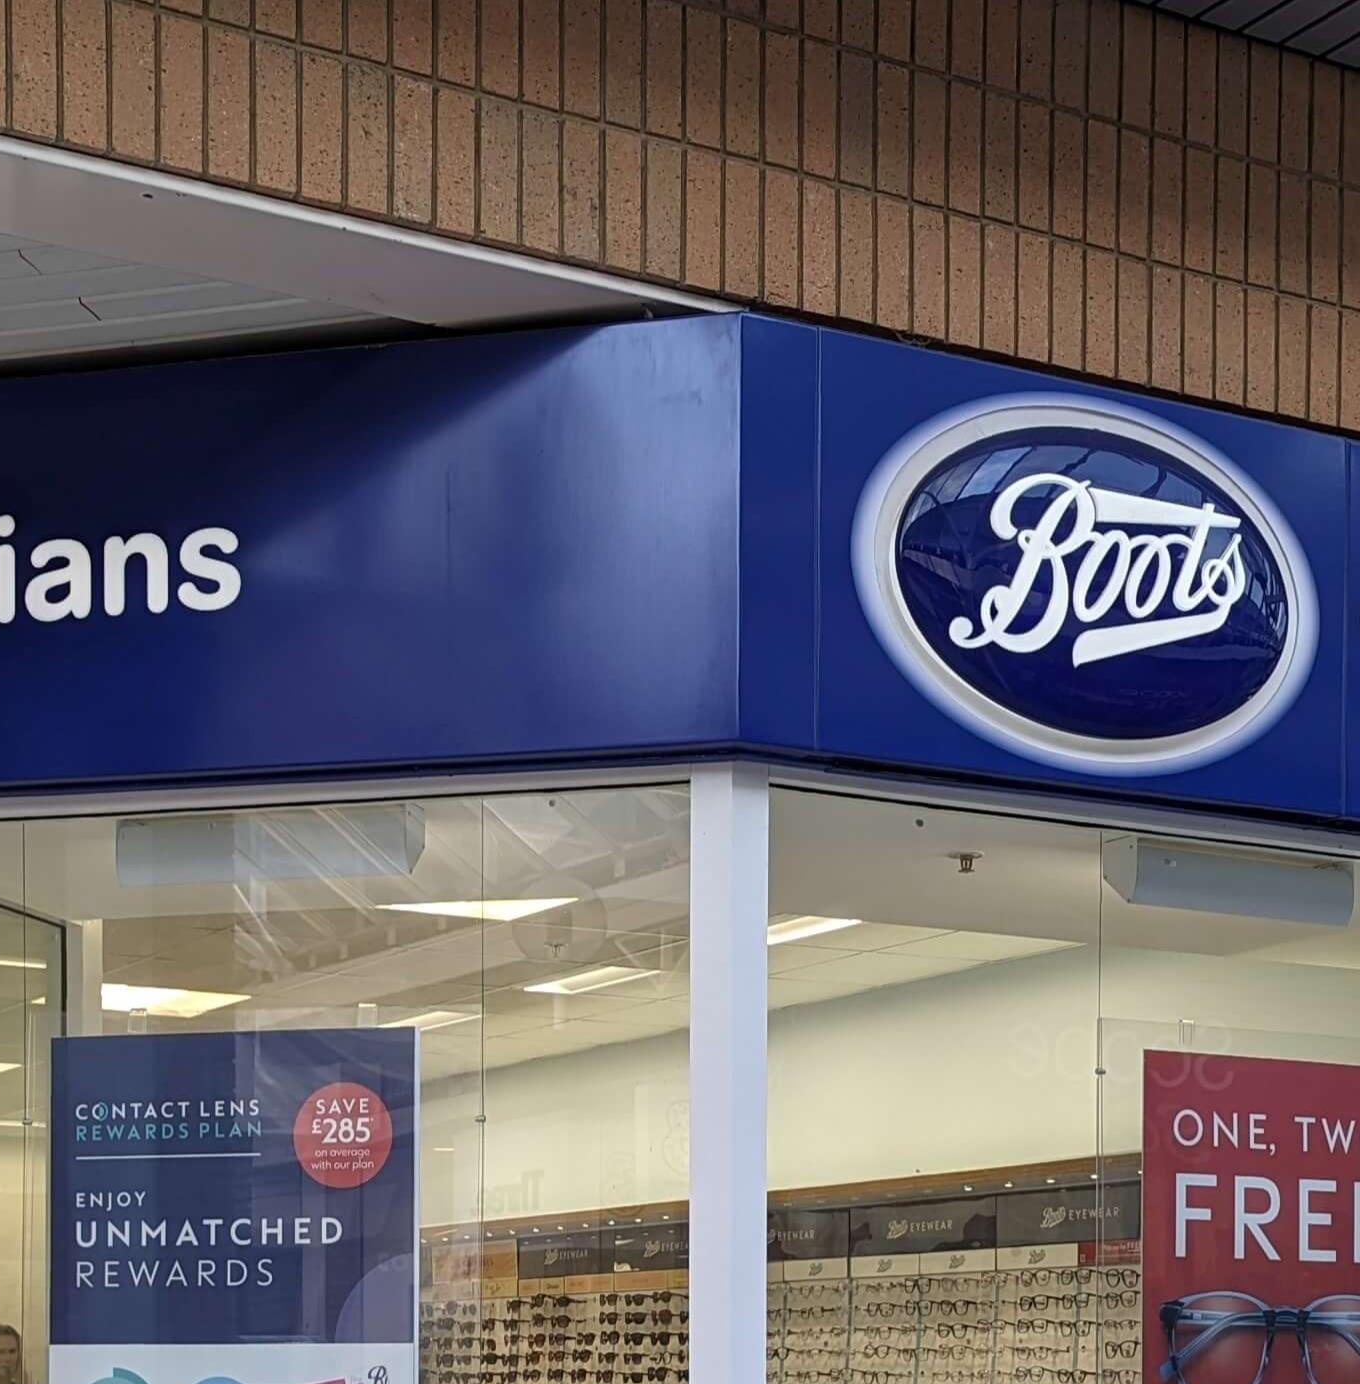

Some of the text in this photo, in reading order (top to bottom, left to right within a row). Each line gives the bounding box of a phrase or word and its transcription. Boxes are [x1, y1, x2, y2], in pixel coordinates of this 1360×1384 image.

[948, 472, 1247, 669] Boots
[75, 1099, 260, 1122] CONTACT LENS
[315, 1098, 369, 1115] SAVE
[76, 1120, 262, 1142] REWARDS PLAN
[1172, 1108, 1277, 1157] ONE,
[314, 1148, 371, 1160] on average
[311, 1159, 375, 1172] with our plan
[76, 1191, 146, 1212] ENJOY
[1068, 1206, 1120, 1221] EYEWEAR
[76, 1217, 344, 1248] UNMATCHED
[909, 1219, 953, 1233] EYEWEAR
[76, 1258, 274, 1288] REWARDS
